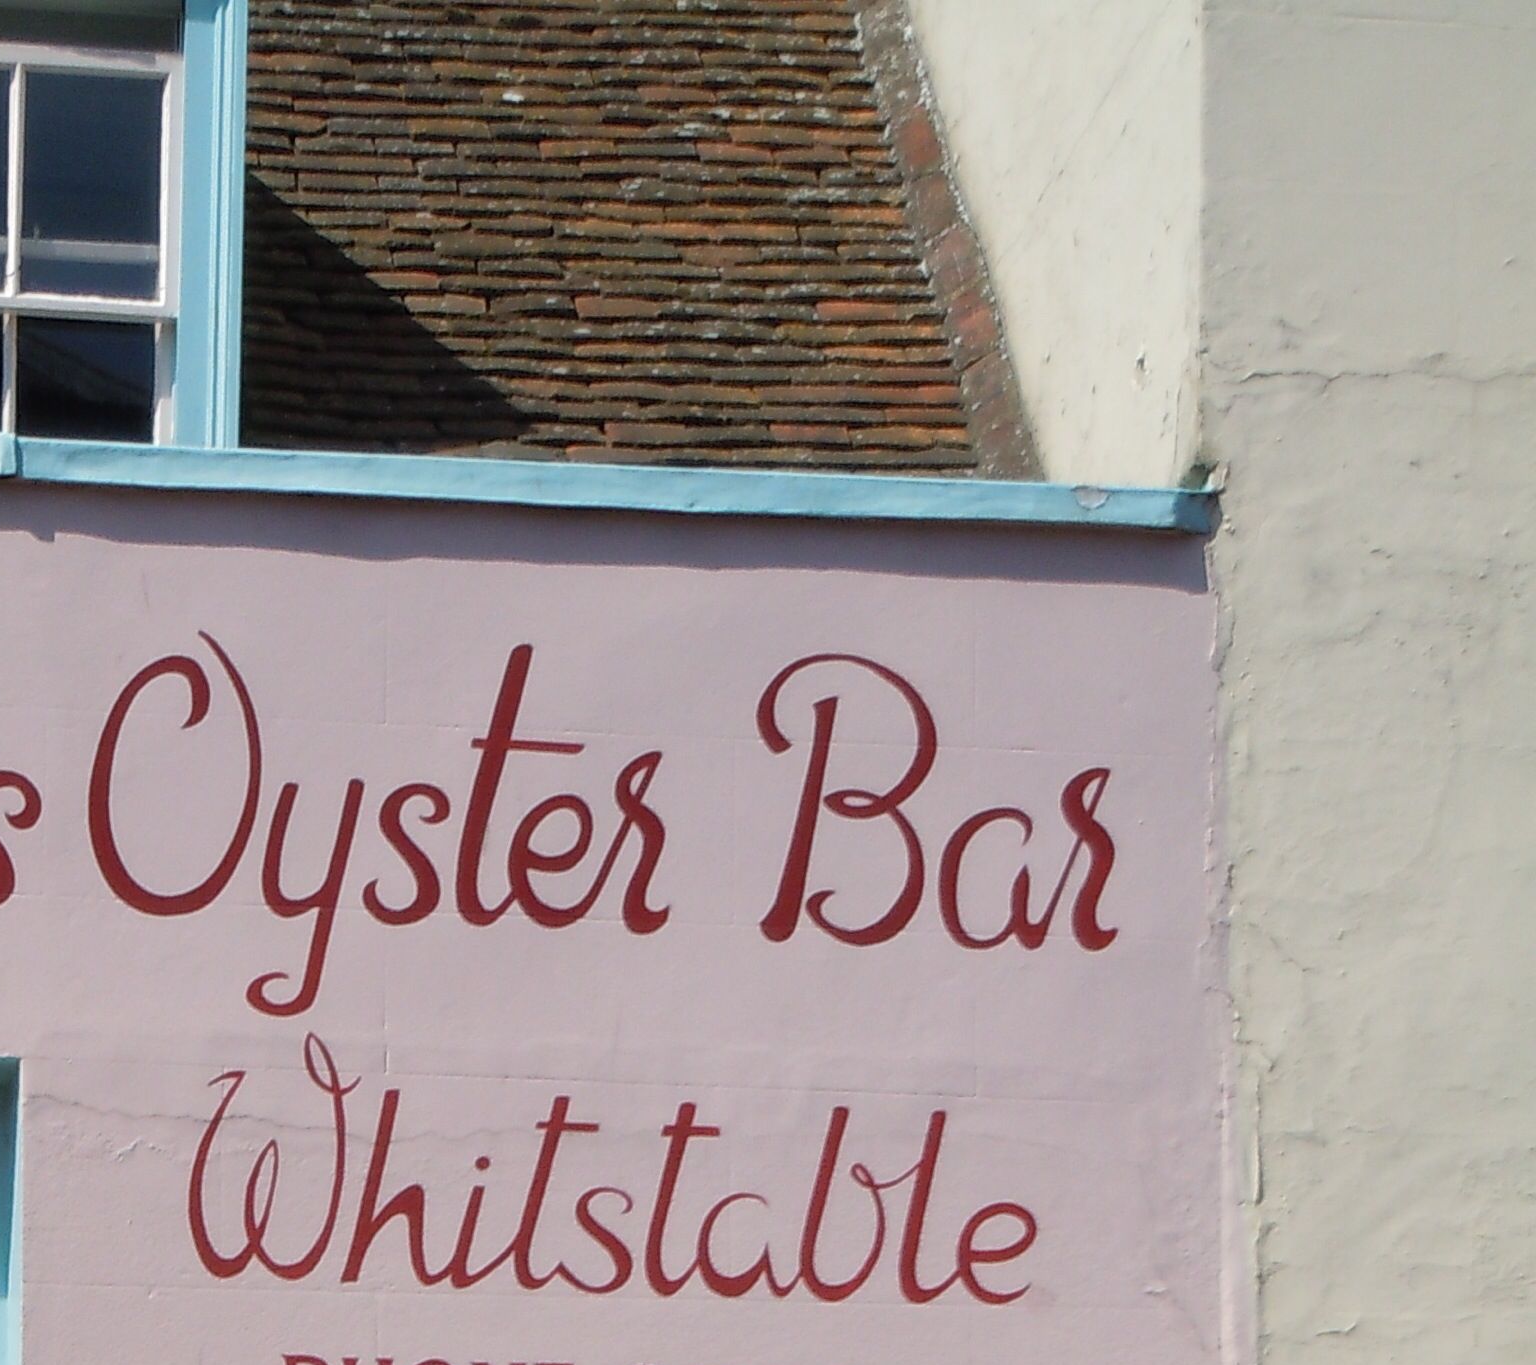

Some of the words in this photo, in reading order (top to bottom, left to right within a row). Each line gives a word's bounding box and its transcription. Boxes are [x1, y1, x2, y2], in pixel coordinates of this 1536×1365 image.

[88, 631, 670, 1017] Oyster
[756, 652, 1117, 951] Bar
[188, 1032, 1037, 1305] Whitstable
